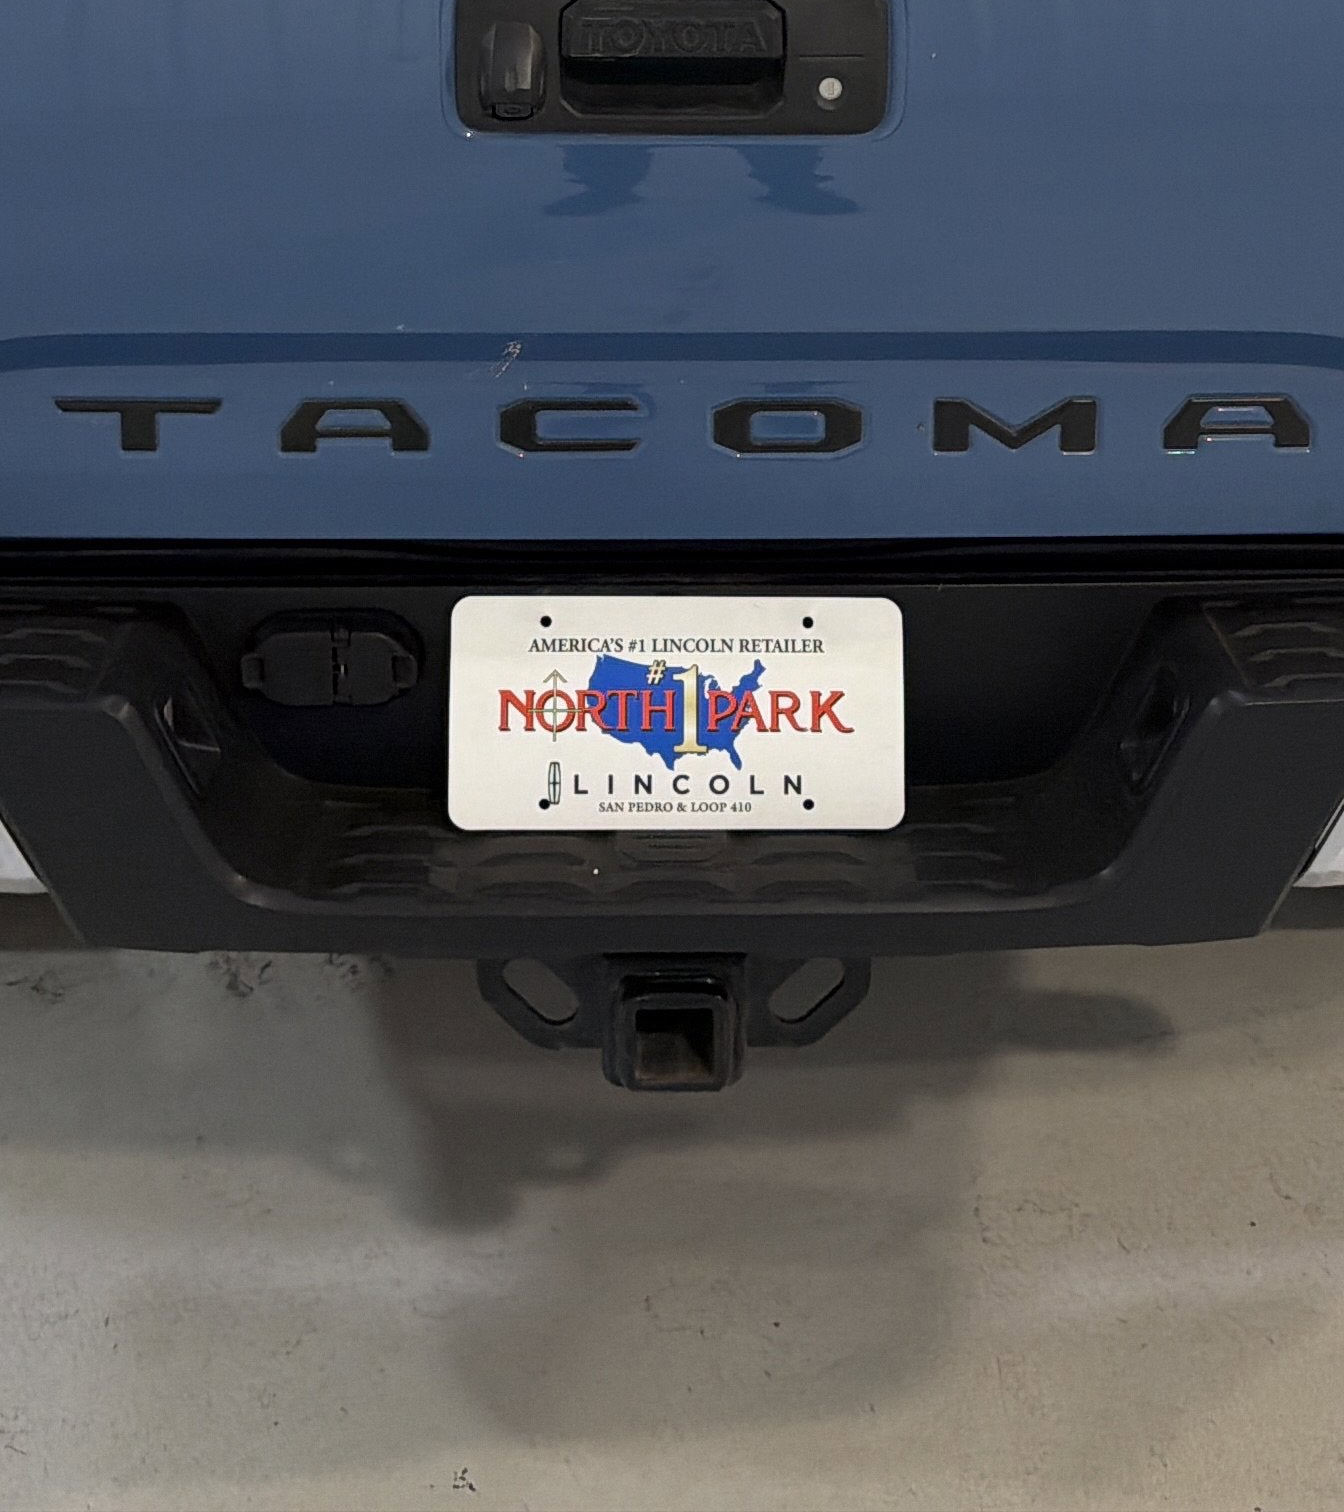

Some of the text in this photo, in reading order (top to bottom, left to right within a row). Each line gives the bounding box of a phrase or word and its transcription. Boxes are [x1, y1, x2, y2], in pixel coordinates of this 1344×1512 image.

[581, 16, 769, 54] TOYOTA
[55, 396, 1311, 454] TACOMA
[528, 638, 825, 653] AMERICA'S #1 LINCOLN RETAILER
[498, 689, 855, 733] NORTH PARK
[573, 774, 803, 795] LINCOLN
[598, 801, 752, 813] SAN PEDRO & LOOP 410
